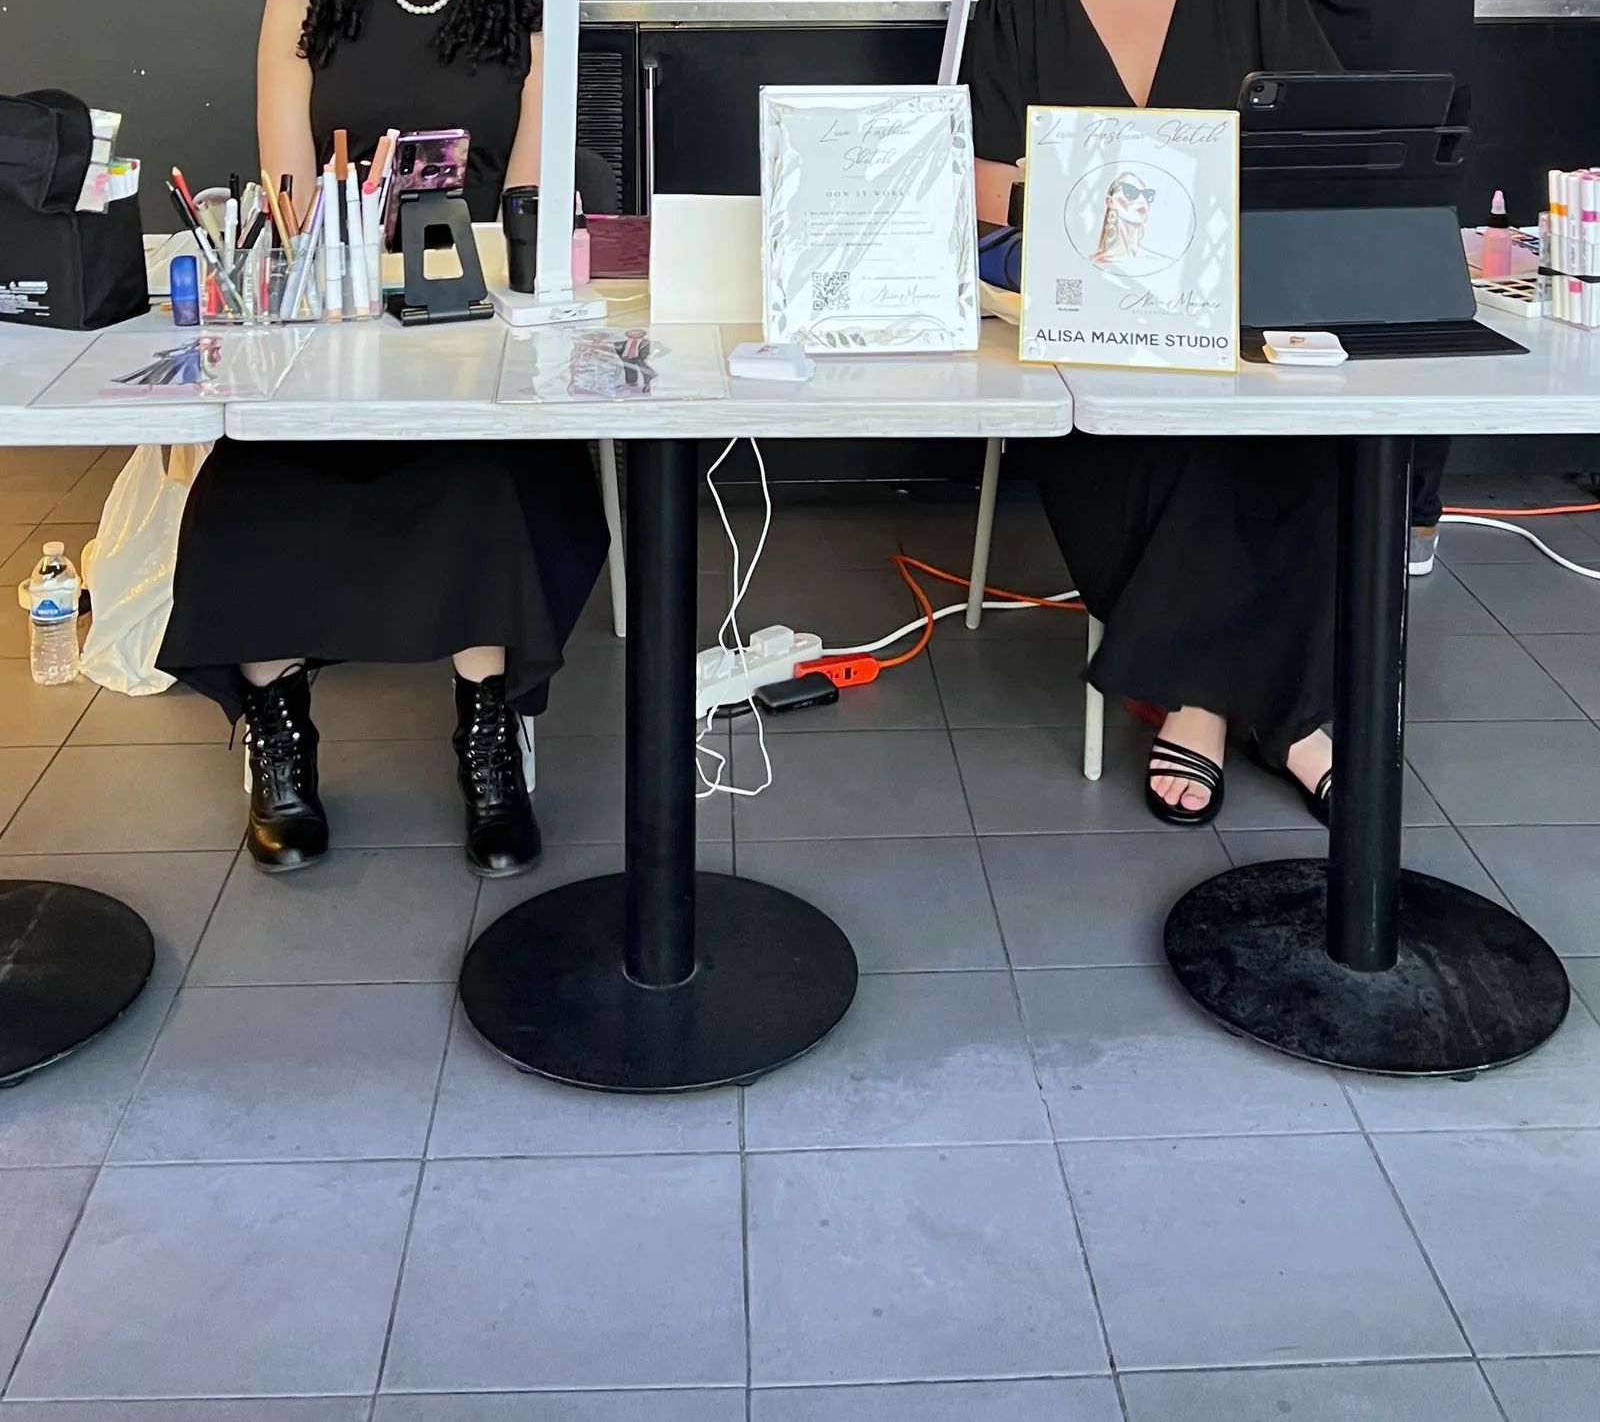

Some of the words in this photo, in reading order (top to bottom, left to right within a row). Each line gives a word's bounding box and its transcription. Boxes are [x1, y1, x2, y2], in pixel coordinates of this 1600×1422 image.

[1154, 119, 1229, 149] Sketch
[1035, 329, 1086, 343] ALISA
[1091, 331, 1160, 346] MAXIME
[1165, 334, 1229, 349] STUDIO
